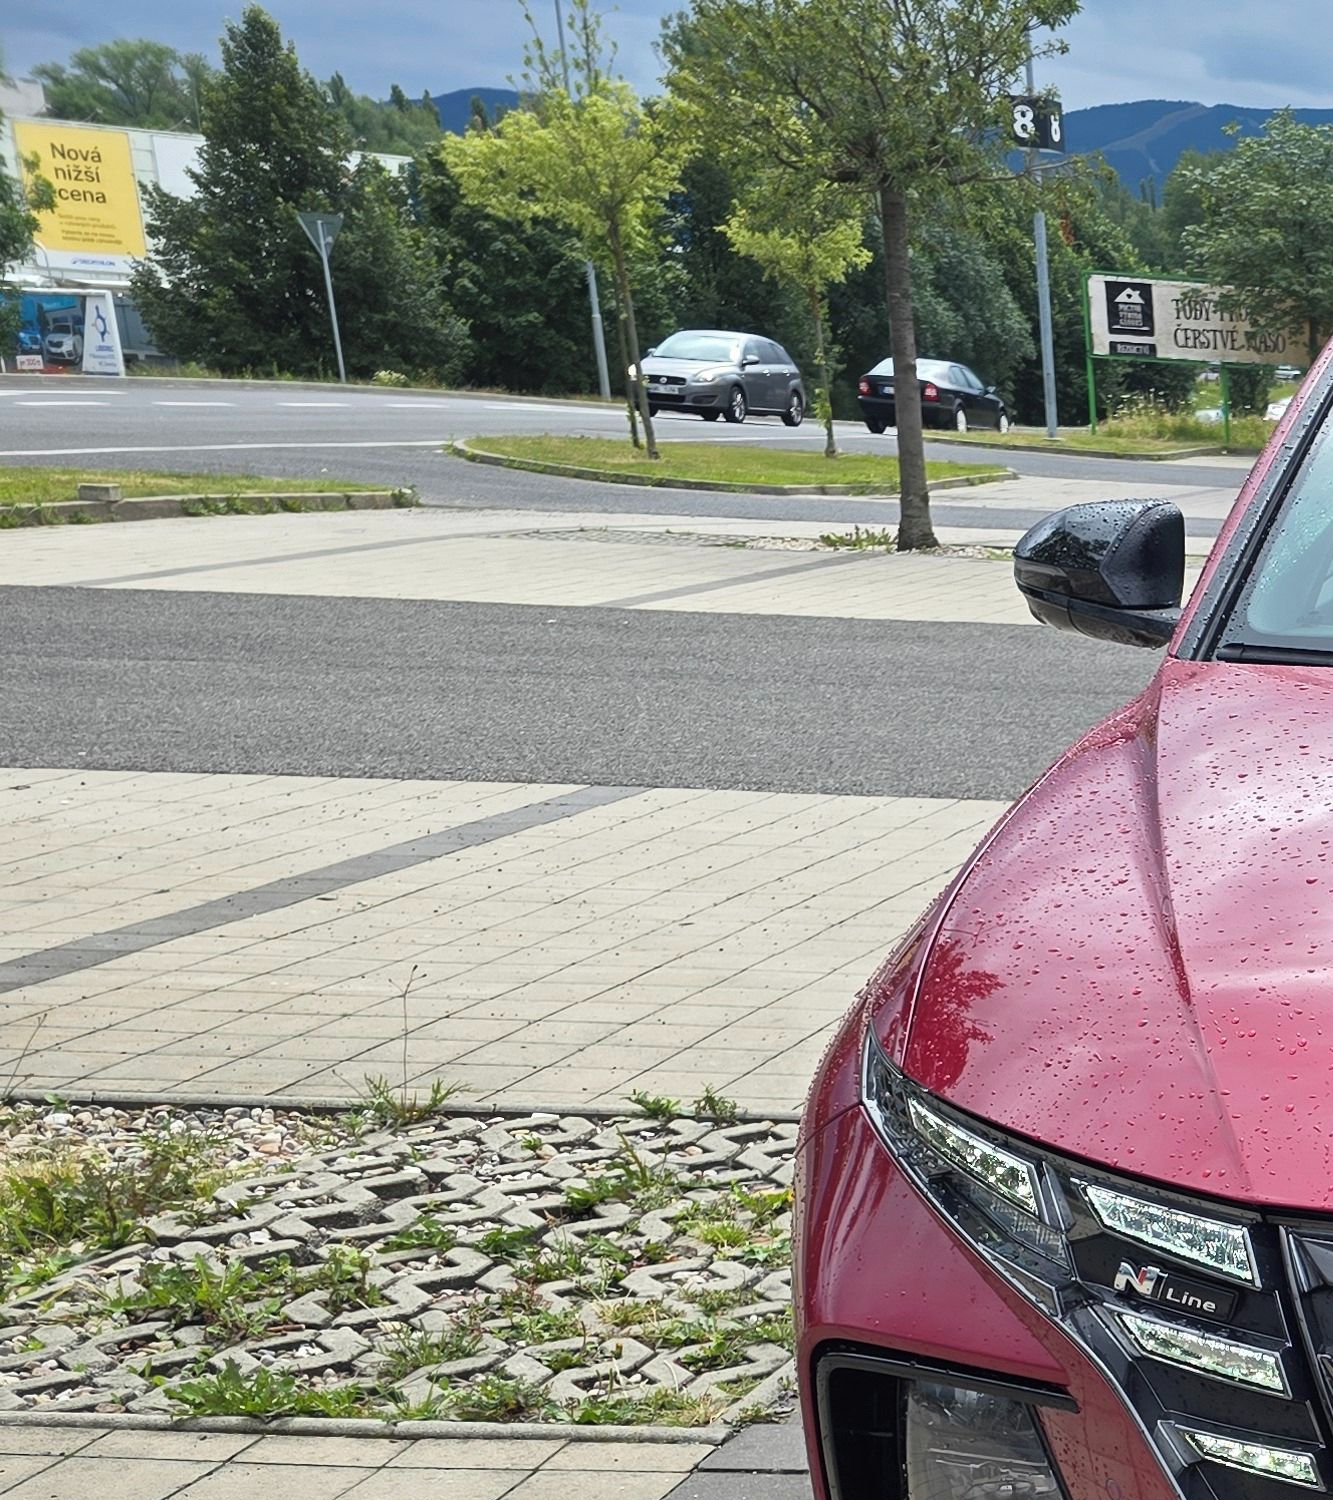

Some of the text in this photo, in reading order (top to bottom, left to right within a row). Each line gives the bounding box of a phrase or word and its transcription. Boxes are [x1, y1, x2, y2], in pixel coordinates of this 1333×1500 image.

[1013, 104, 1035, 138] 8
[50, 142, 102, 163] Nová
[54, 164, 101, 183] nižší
[57, 188, 107, 204] cena
[1174, 324, 1240, 351] ČERSTVÉ
[1166, 1288, 1216, 1313] Line
